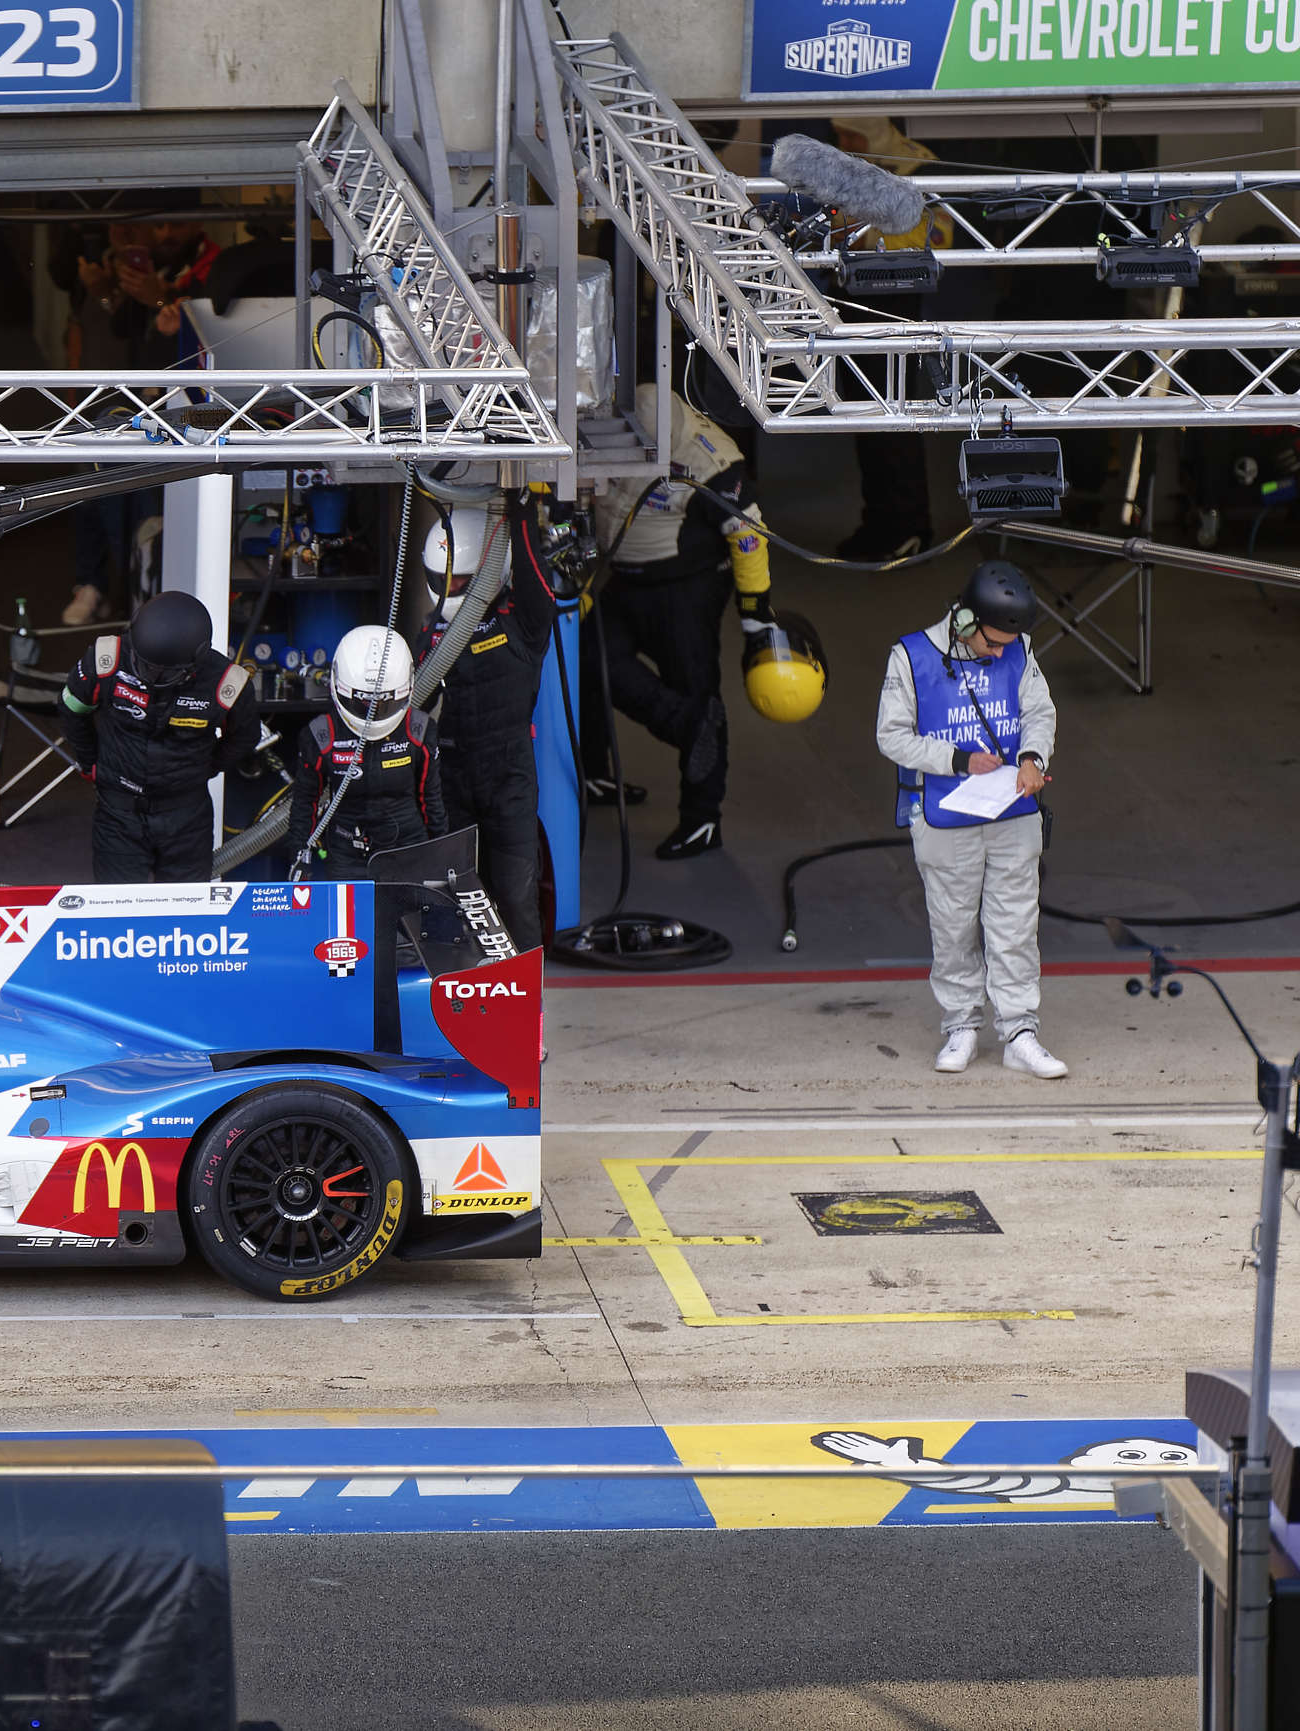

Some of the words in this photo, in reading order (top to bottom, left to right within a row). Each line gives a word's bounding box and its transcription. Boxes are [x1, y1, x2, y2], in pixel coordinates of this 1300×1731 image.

[969, 0, 1232, 62] CHEVROLET
[788, 36, 909, 76] SUPERFINALE
[117, 686, 147, 706] TOTAL
[56, 926, 250, 961] binderholz
[326, 947, 357, 959] 1969
[157, 960, 199, 976] tiptop
[203, 959, 248, 974] timber
[439, 981, 527, 998] TOTAL
[151, 1117, 194, 1125] SERFIM
[447, 1196, 529, 1209] DUNLOP
[293, 1214, 398, 1295] DUNLOP
